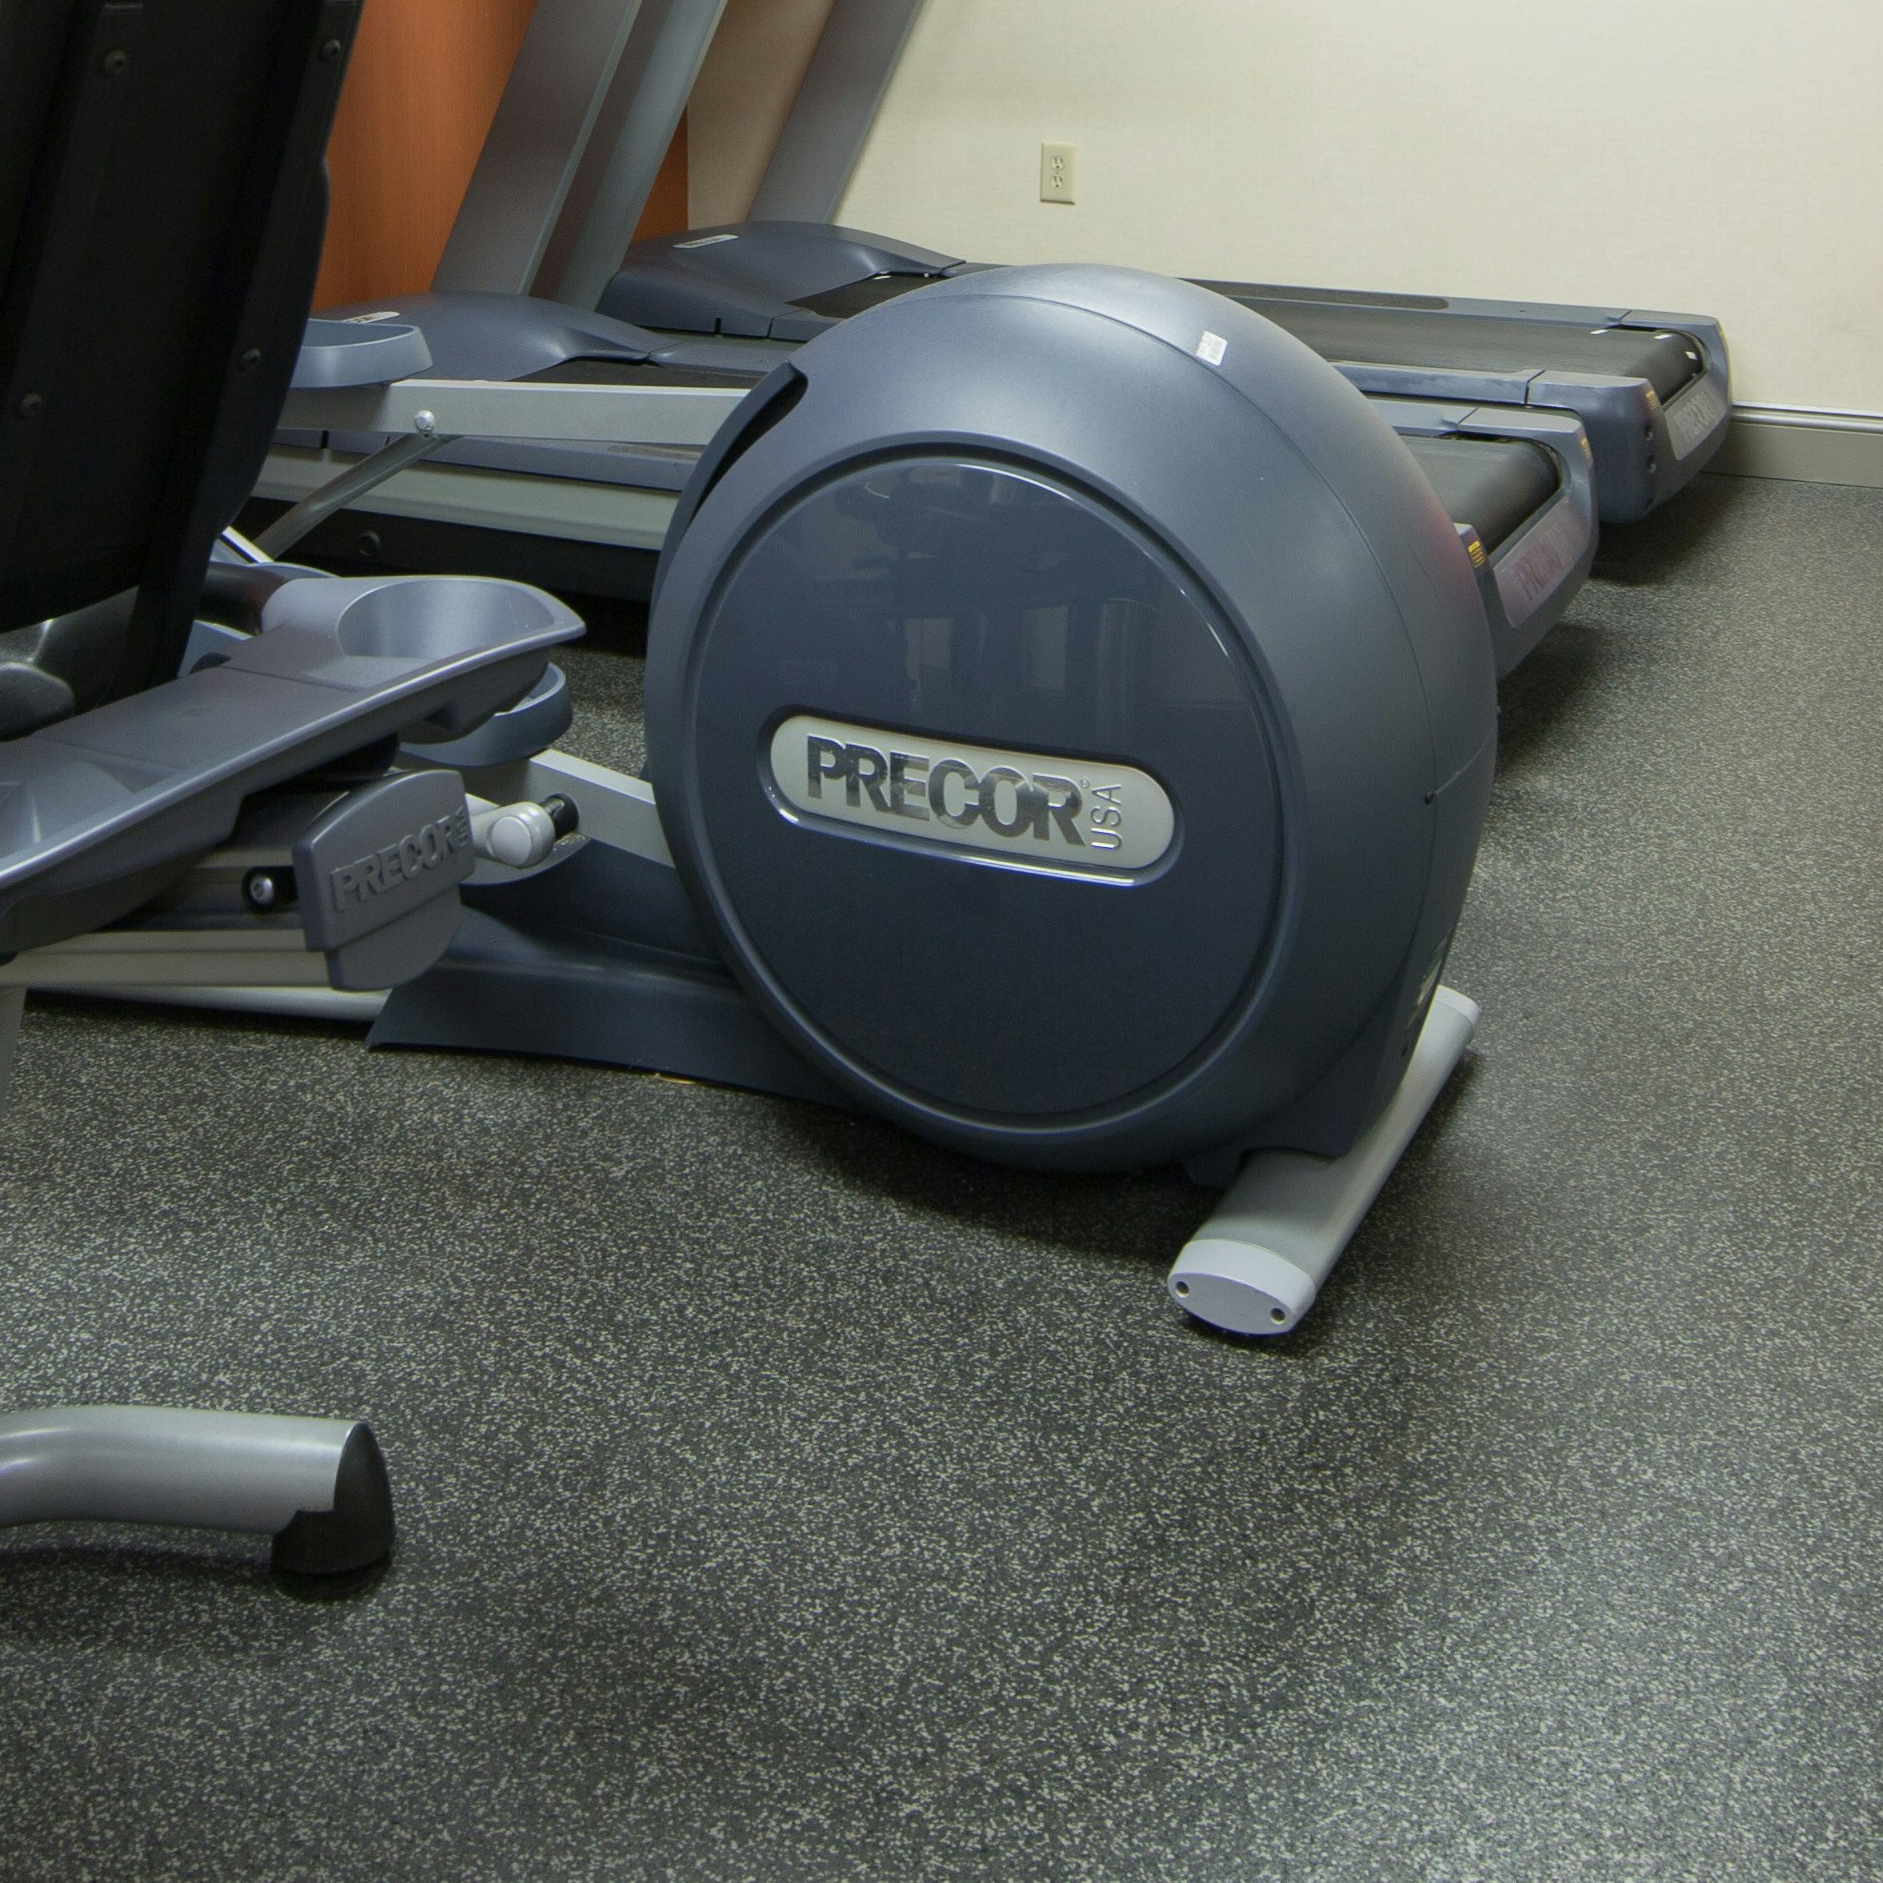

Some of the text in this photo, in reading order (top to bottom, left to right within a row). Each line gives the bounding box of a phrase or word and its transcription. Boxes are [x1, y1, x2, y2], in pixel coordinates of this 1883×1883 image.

[805, 733, 1124, 851] PRECOR USA
[330, 815, 458, 912] PRECOR
